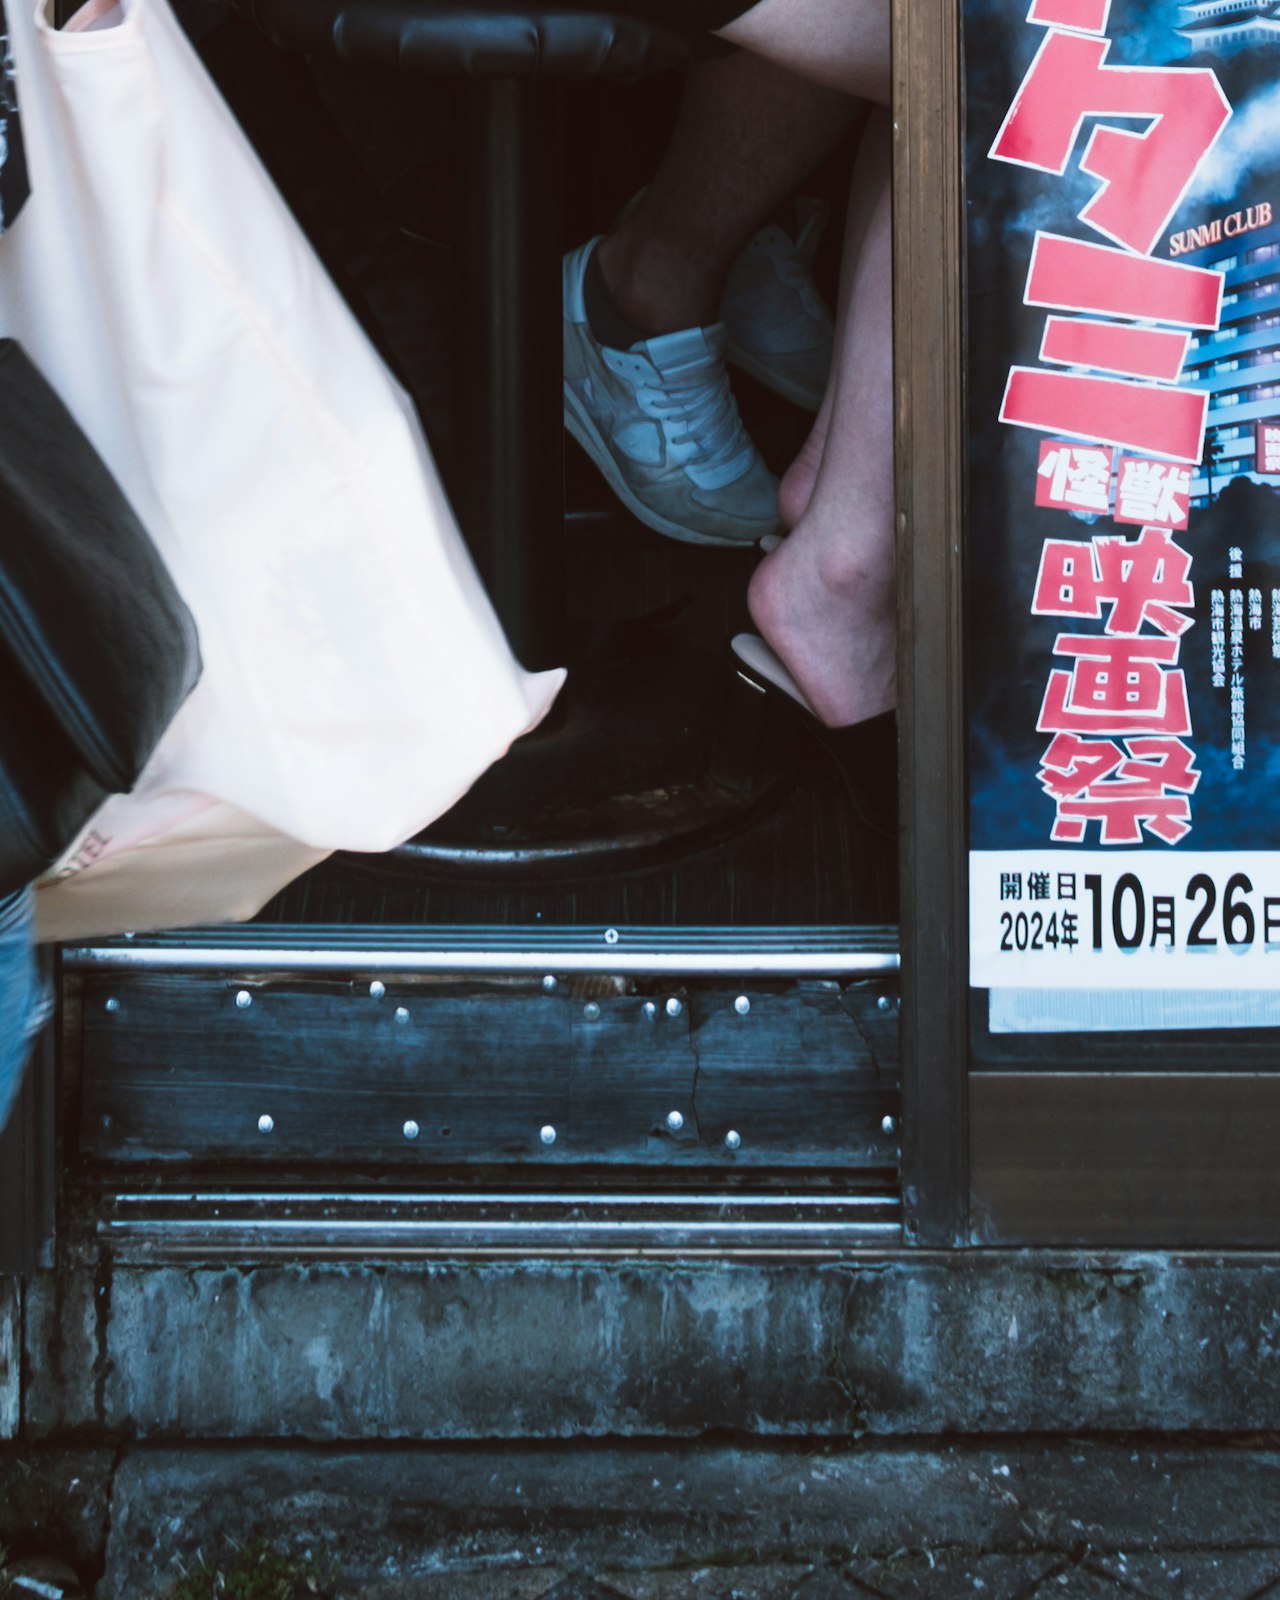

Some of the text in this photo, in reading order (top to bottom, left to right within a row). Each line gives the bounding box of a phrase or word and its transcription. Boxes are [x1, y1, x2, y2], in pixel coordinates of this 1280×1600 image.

[1169, 201, 1273, 257] SUNMI CLUB
[1035, 441, 1190, 531] 怪獣
[1228, 546, 1243, 579] 後援
[1248, 587, 1263, 631] 熱海市
[1210, 587, 1226, 688] 熱海市観光協会
[1033, 528, 1201, 845] 映画祭
[999, 871, 1078, 901] 開催日
[999, 910, 1079, 954] 2024年
